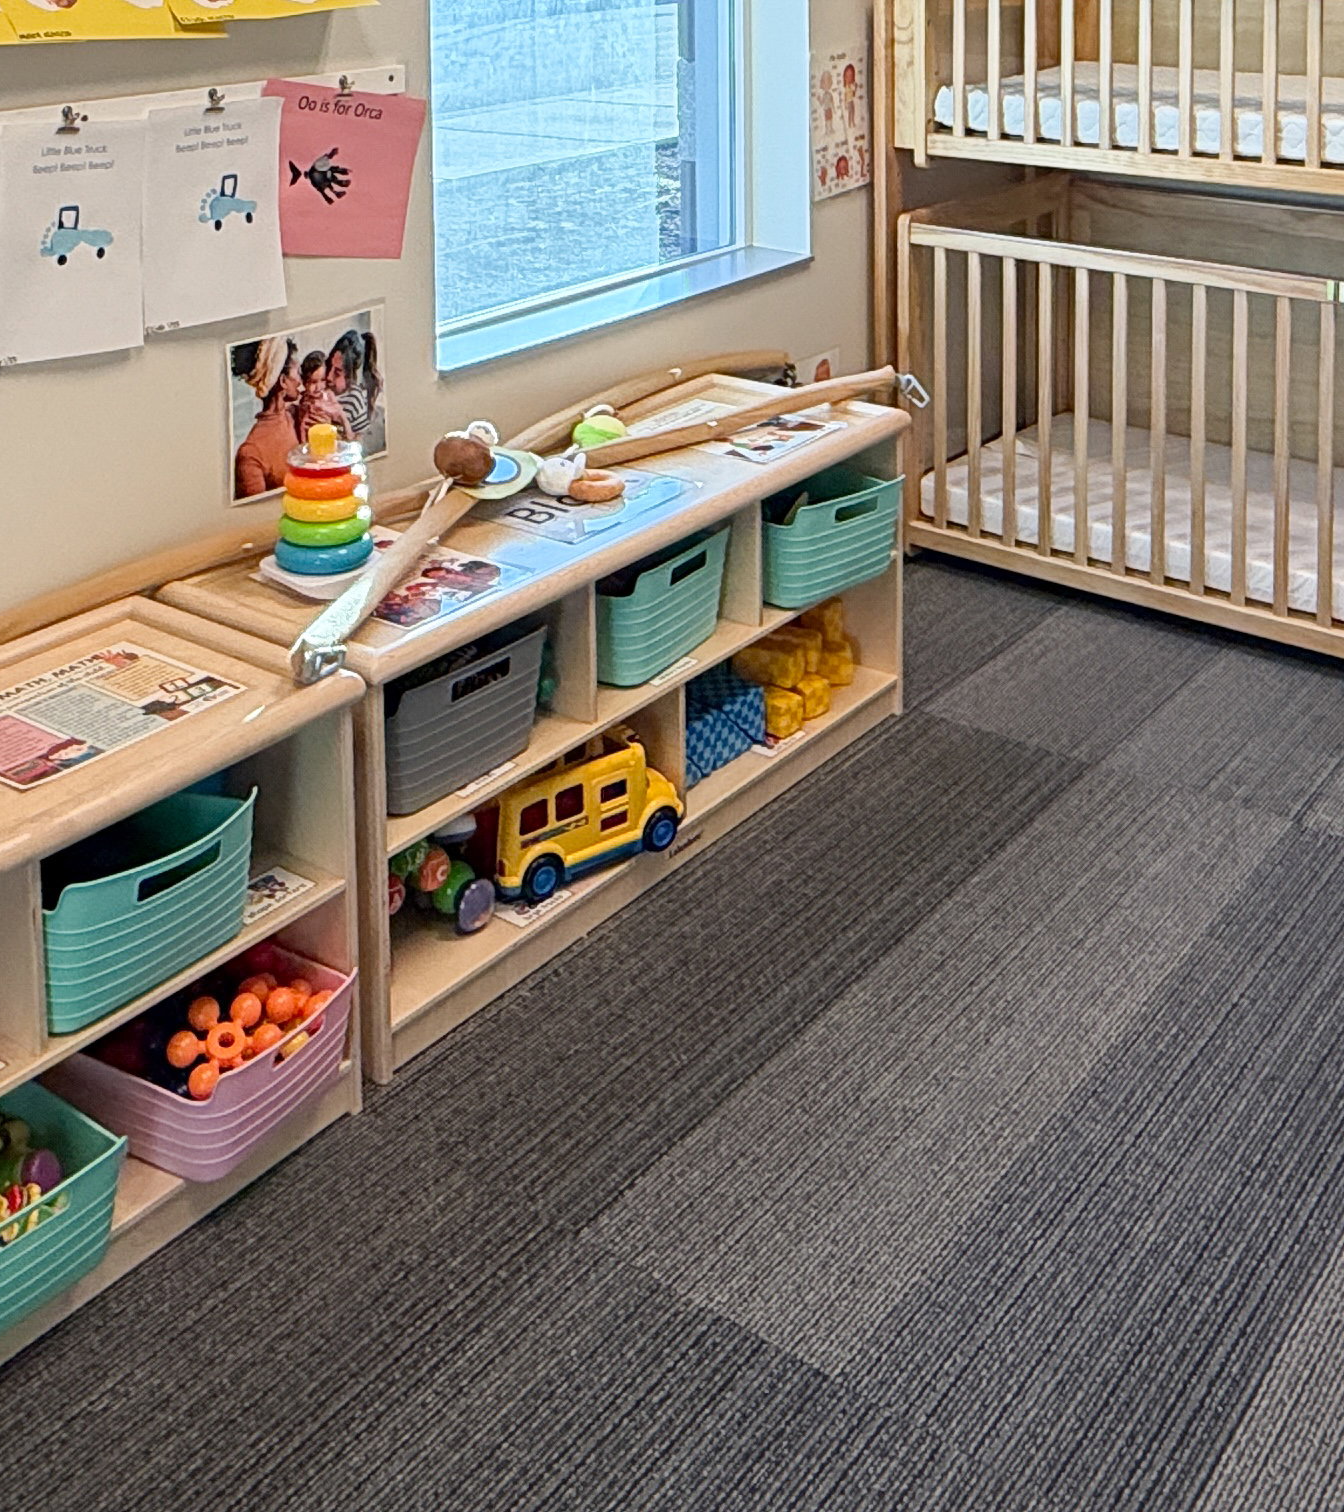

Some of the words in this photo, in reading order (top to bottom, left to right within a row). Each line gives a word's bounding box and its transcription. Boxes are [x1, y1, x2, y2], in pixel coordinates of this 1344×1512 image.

[298, 95, 317, 113] Oo
[320, 98, 330, 114] is
[333, 100, 352, 117] for
[354, 103, 384, 121] Orca
